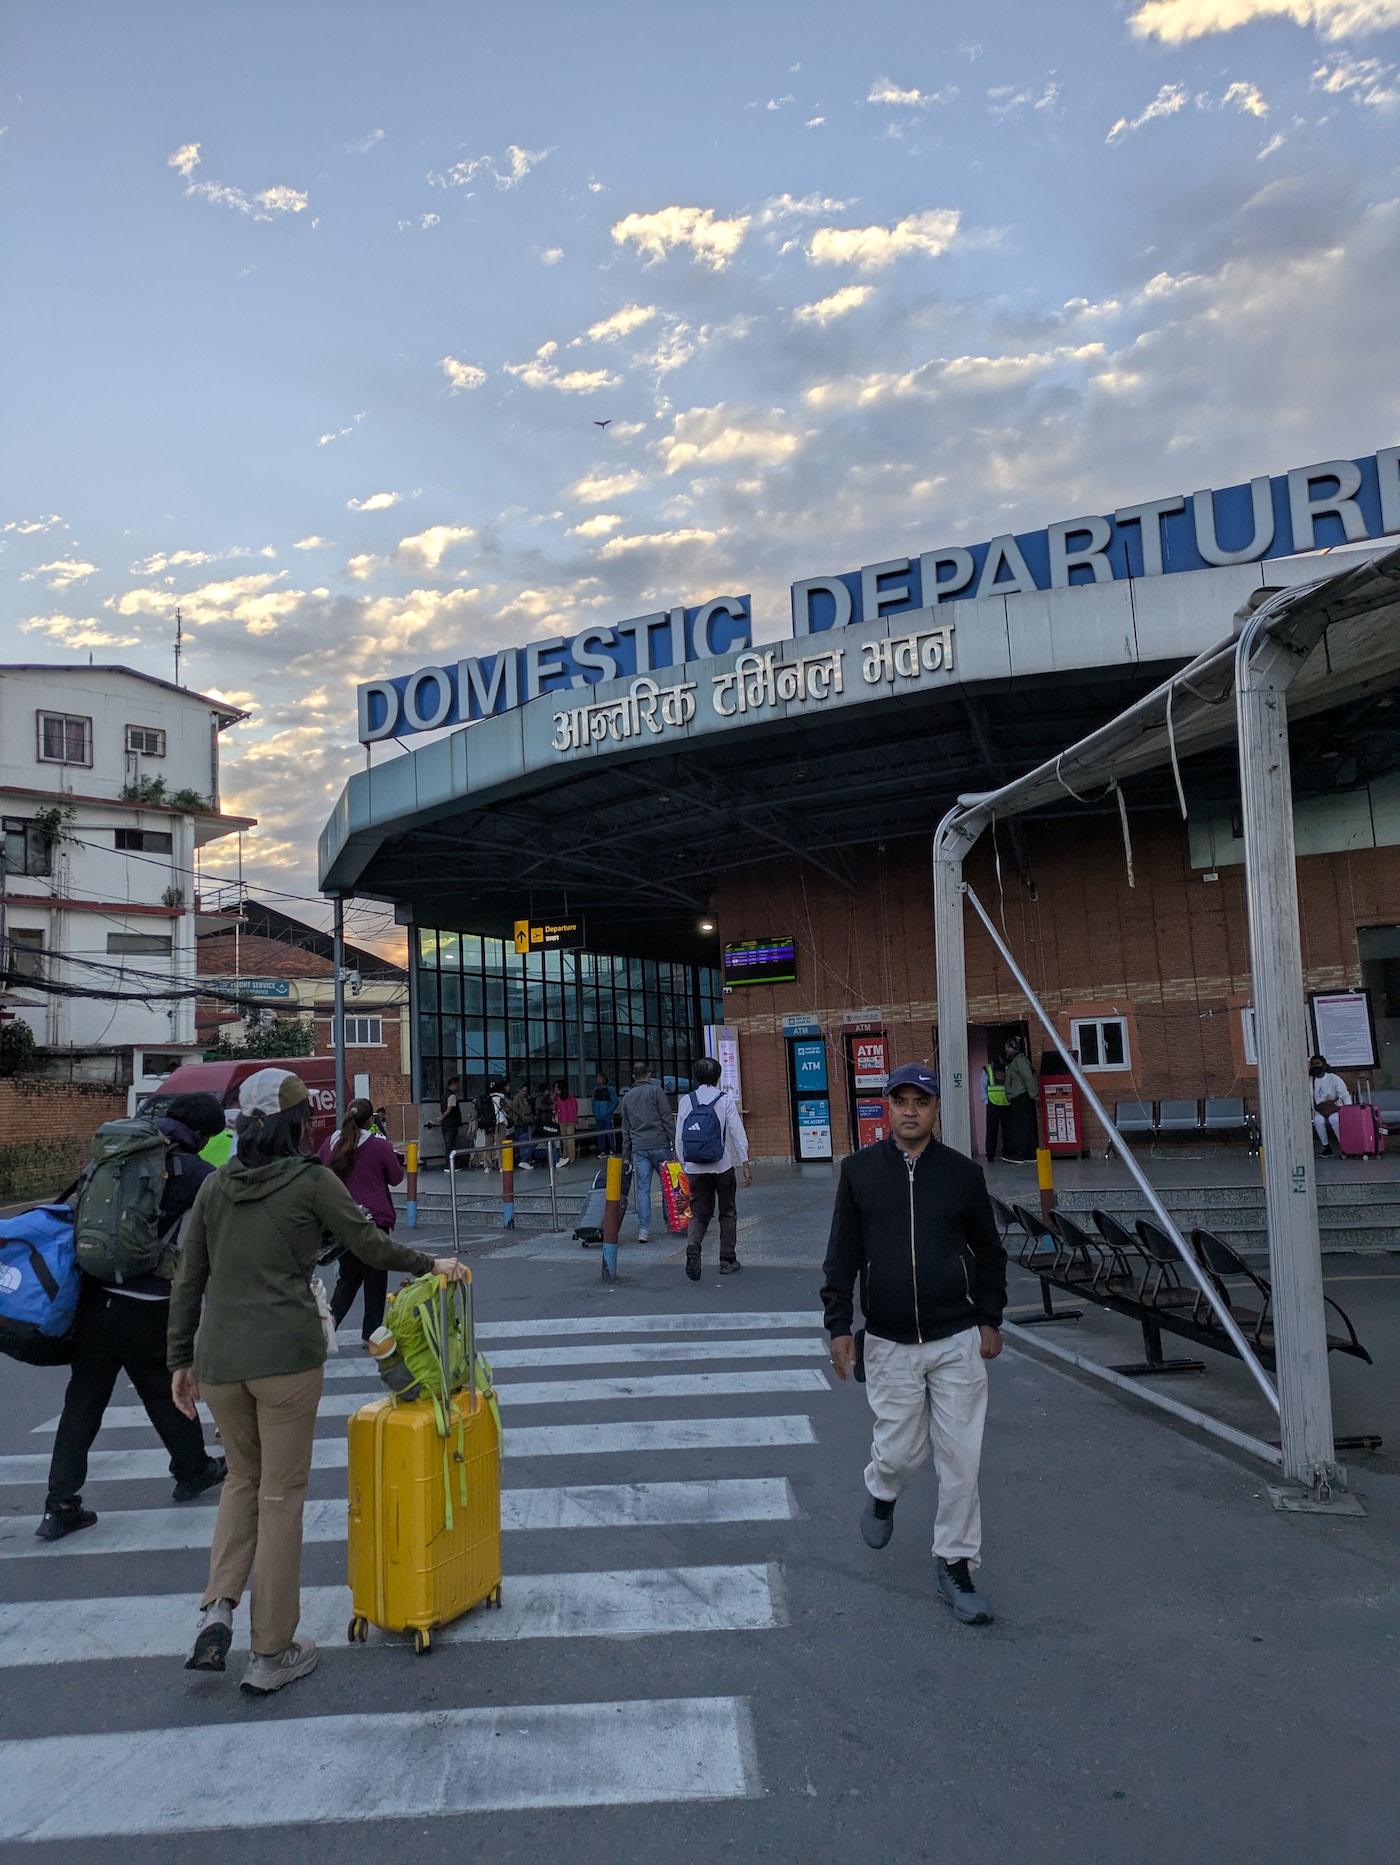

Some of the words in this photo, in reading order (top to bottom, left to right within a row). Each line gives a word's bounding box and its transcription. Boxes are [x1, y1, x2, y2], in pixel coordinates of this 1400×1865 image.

[358, 597, 748, 742] DOMESTIC
[552, 677, 697, 751] आन्तरिक
[712, 649, 845, 716] टर्मिनल
[863, 624, 956, 684] भवन
[545, 925, 577, 933] Departure
[794, 1027, 809, 1035] ATM
[855, 1024, 871, 1032] ATM
[857, 1045, 883, 1056] ATM
[802, 1061, 820, 1071] ATM
